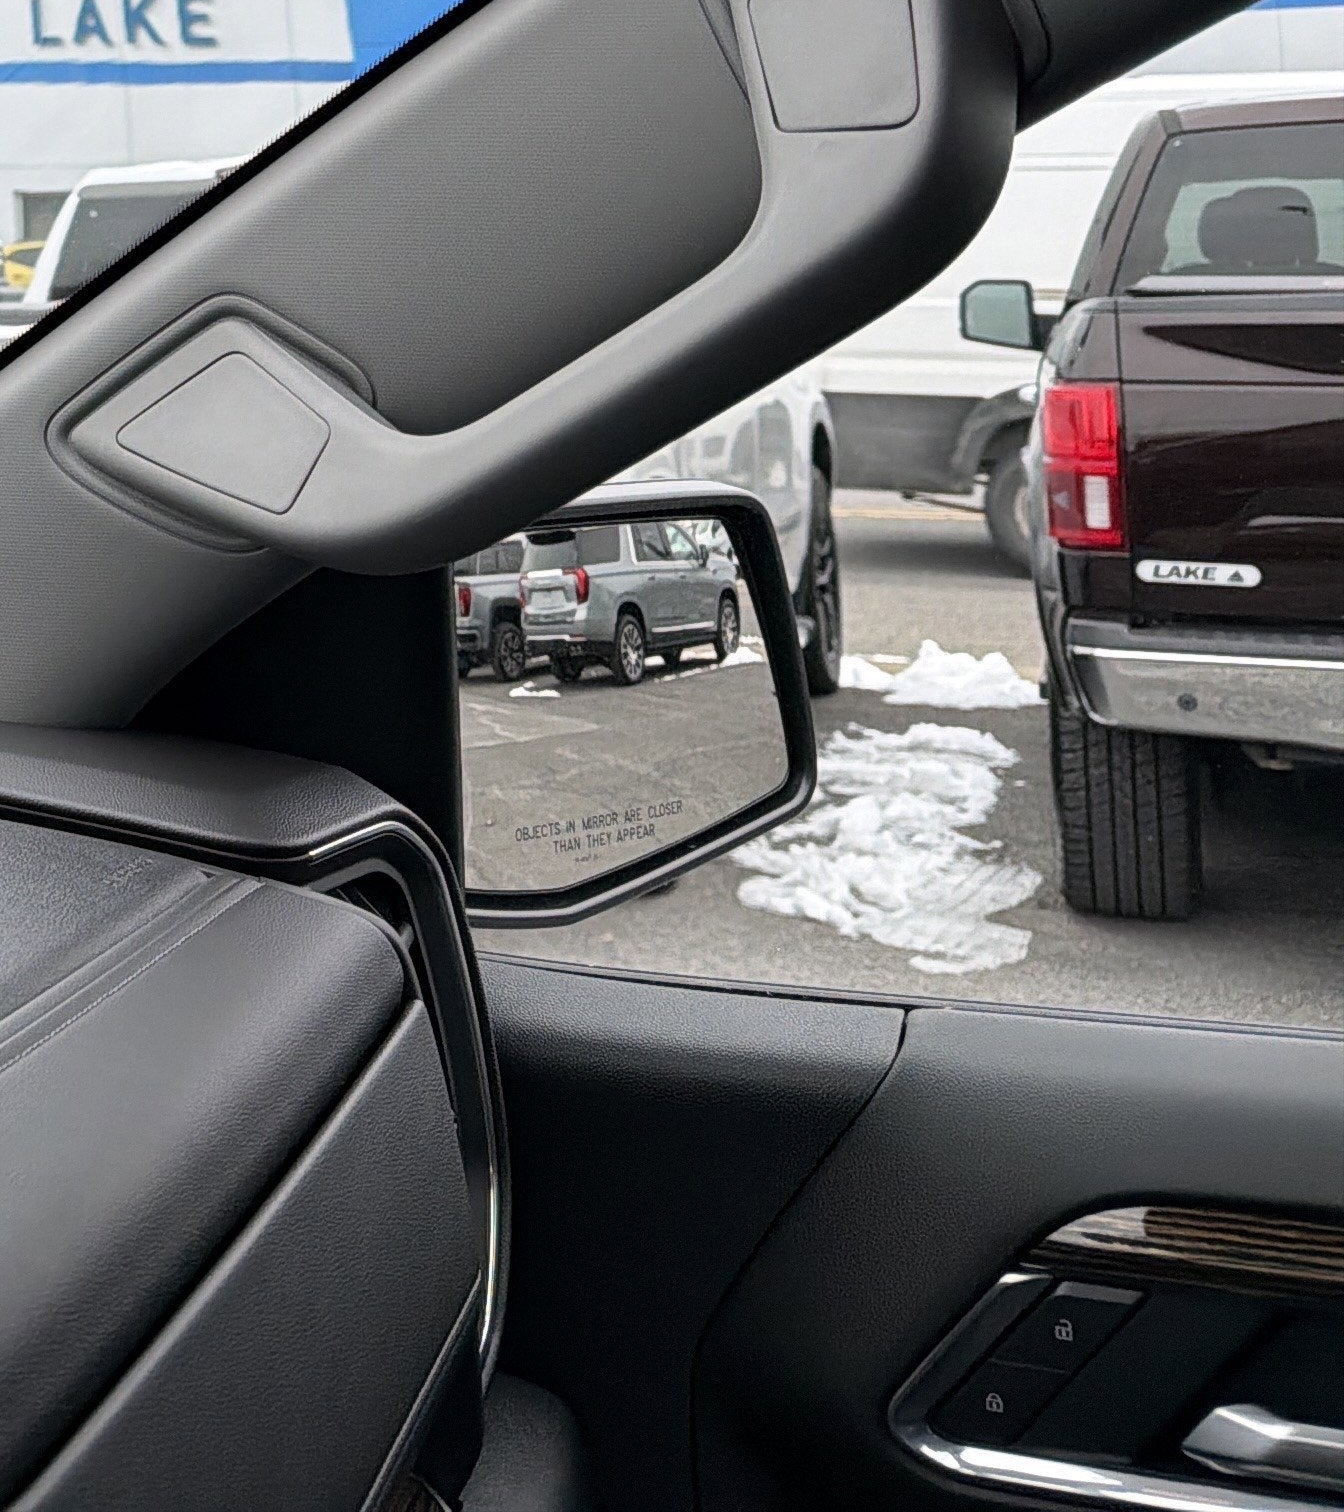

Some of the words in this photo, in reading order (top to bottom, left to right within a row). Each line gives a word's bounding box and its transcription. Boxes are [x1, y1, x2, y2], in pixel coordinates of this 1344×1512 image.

[1152, 564, 1218, 582] LAKE
[515, 821, 562, 842] OBJECTS
[565, 819, 576, 833] IN
[581, 812, 619, 831] MIRROR
[624, 807, 643, 824] ARE
[647, 800, 683, 819] CLOSER
[553, 838, 581, 854] THAN
[585, 833, 612, 849] THEY
[616, 823, 656, 843] APPEAR
